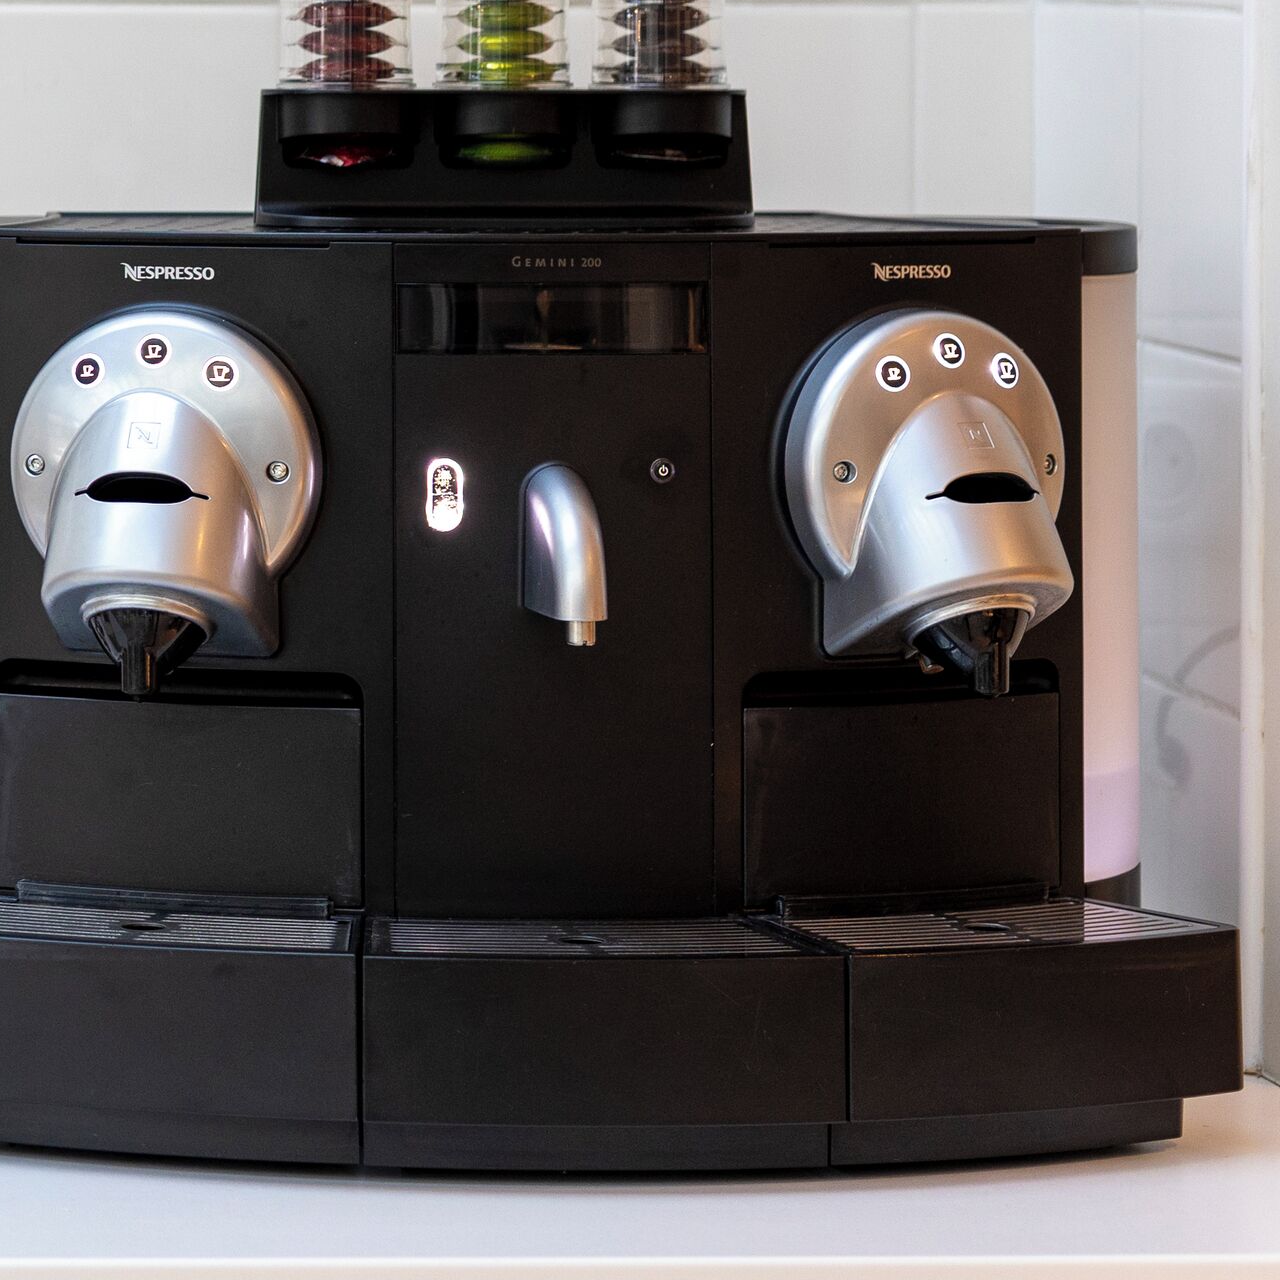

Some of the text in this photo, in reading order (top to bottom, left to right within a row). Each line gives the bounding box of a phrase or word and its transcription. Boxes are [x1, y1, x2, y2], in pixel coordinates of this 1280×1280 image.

[511, 256, 602, 267] GEMINI 200
[120, 262, 215, 281] NESPRESSO
[870, 262, 951, 281] NESPRESSO
